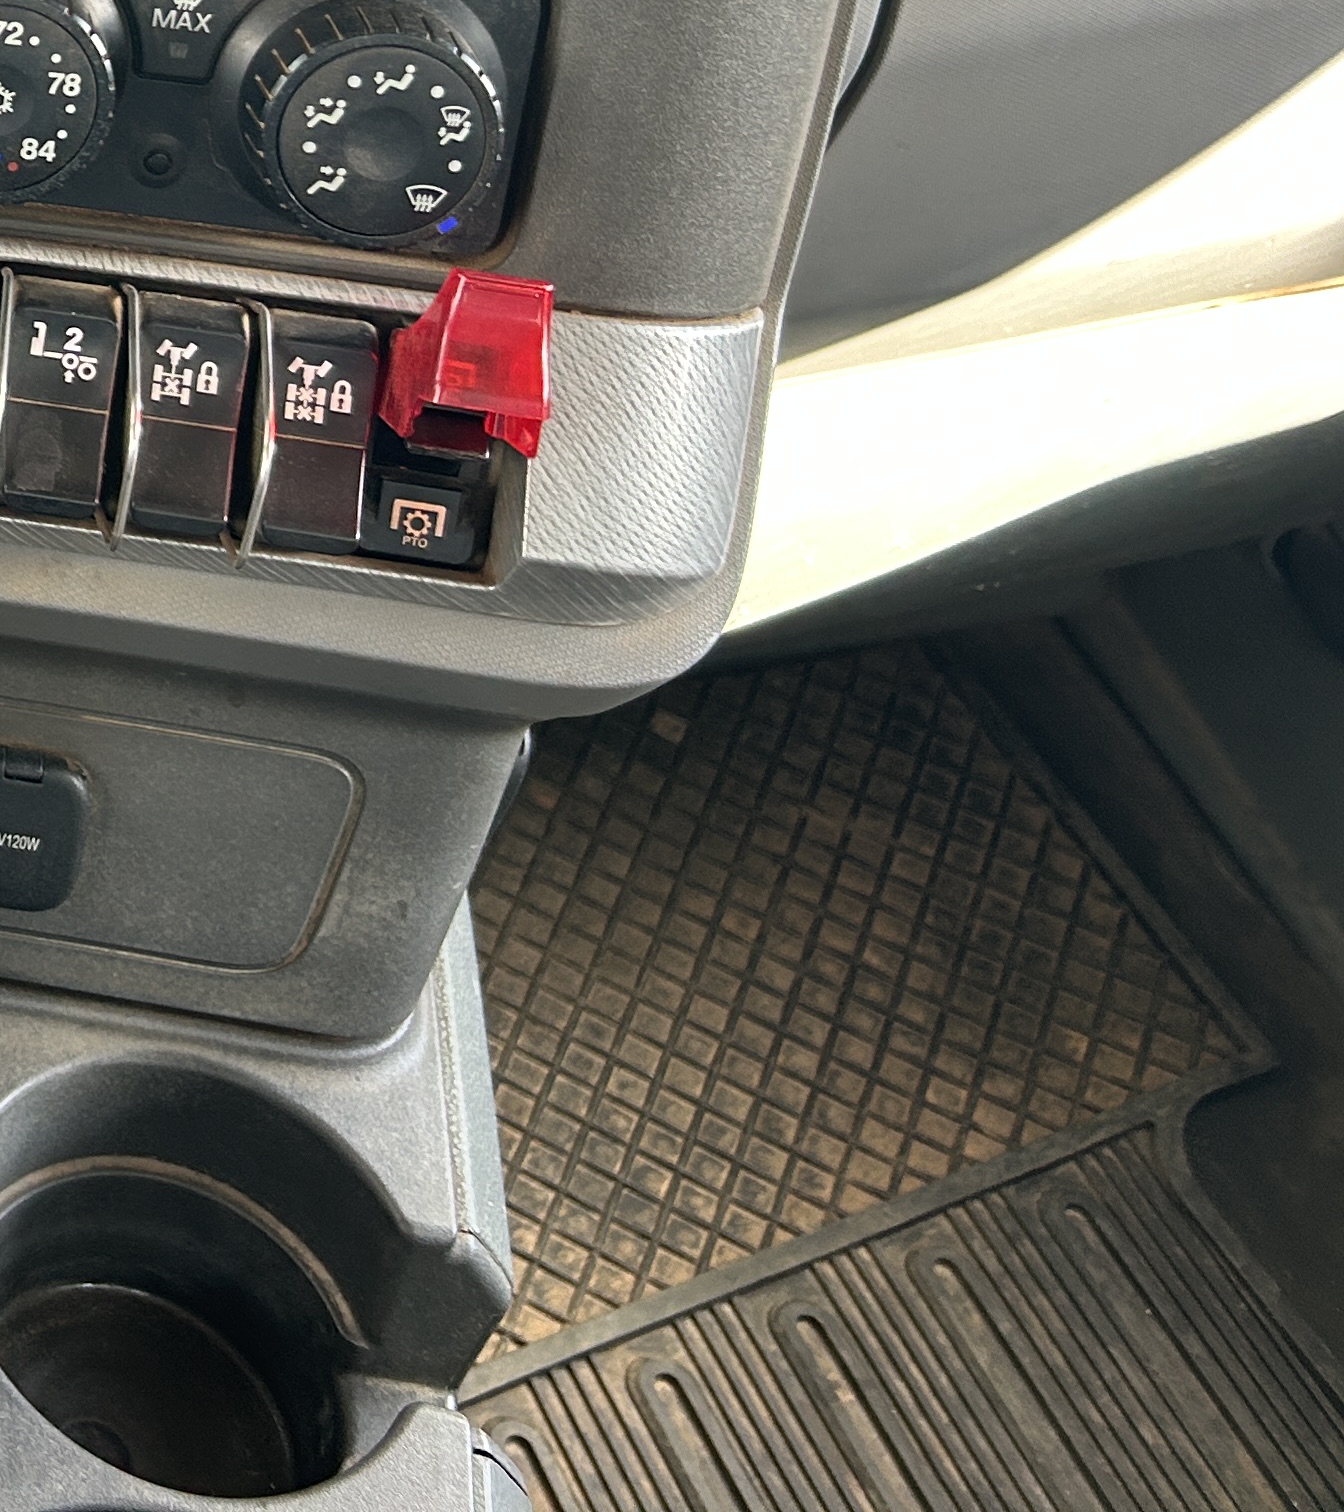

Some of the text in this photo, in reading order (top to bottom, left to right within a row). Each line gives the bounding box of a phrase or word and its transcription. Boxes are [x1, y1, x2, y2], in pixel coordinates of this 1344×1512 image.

[152, 7, 213, 34] MAX
[47, 70, 82, 98] 78
[19, 138, 57, 162] 84
[62, 326, 85, 352] 2
[401, 535, 428, 549] PTO
